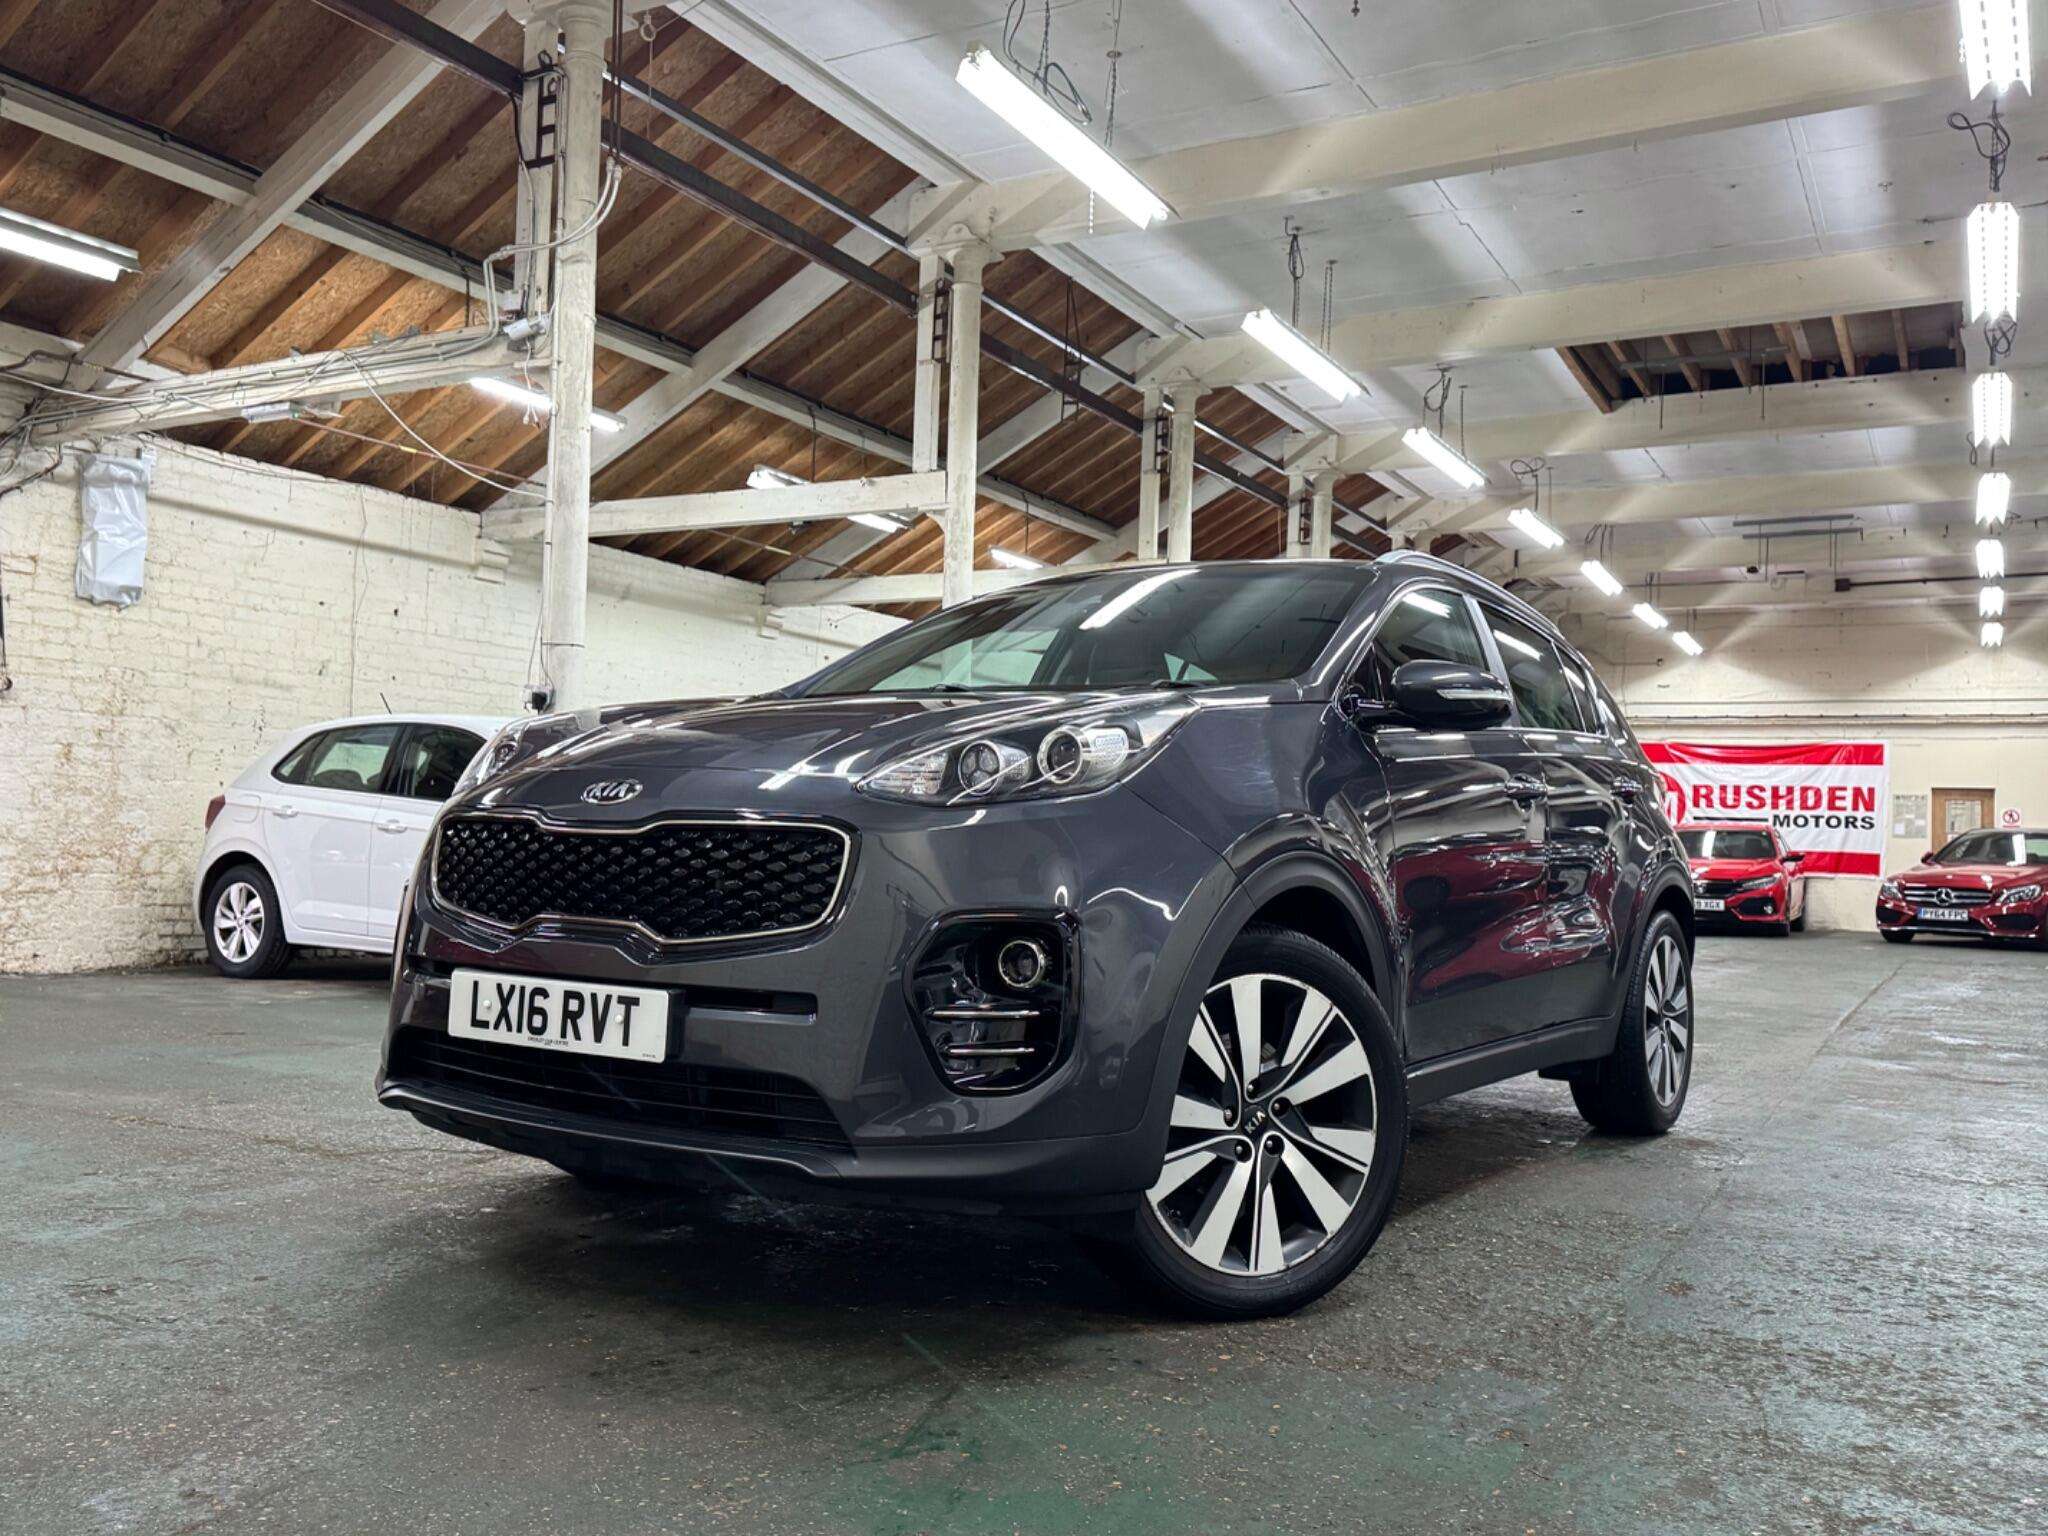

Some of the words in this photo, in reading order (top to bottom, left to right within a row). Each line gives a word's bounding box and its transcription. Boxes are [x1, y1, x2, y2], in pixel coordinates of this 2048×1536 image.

[589, 781, 631, 799] KIA
[1692, 784, 1875, 812] RUSHDEN
[1772, 815, 1875, 830] MOTORS
[470, 980, 550, 1036] LX16
[560, 989, 640, 1047] RVT
[1245, 1111, 1265, 1134] KIA
